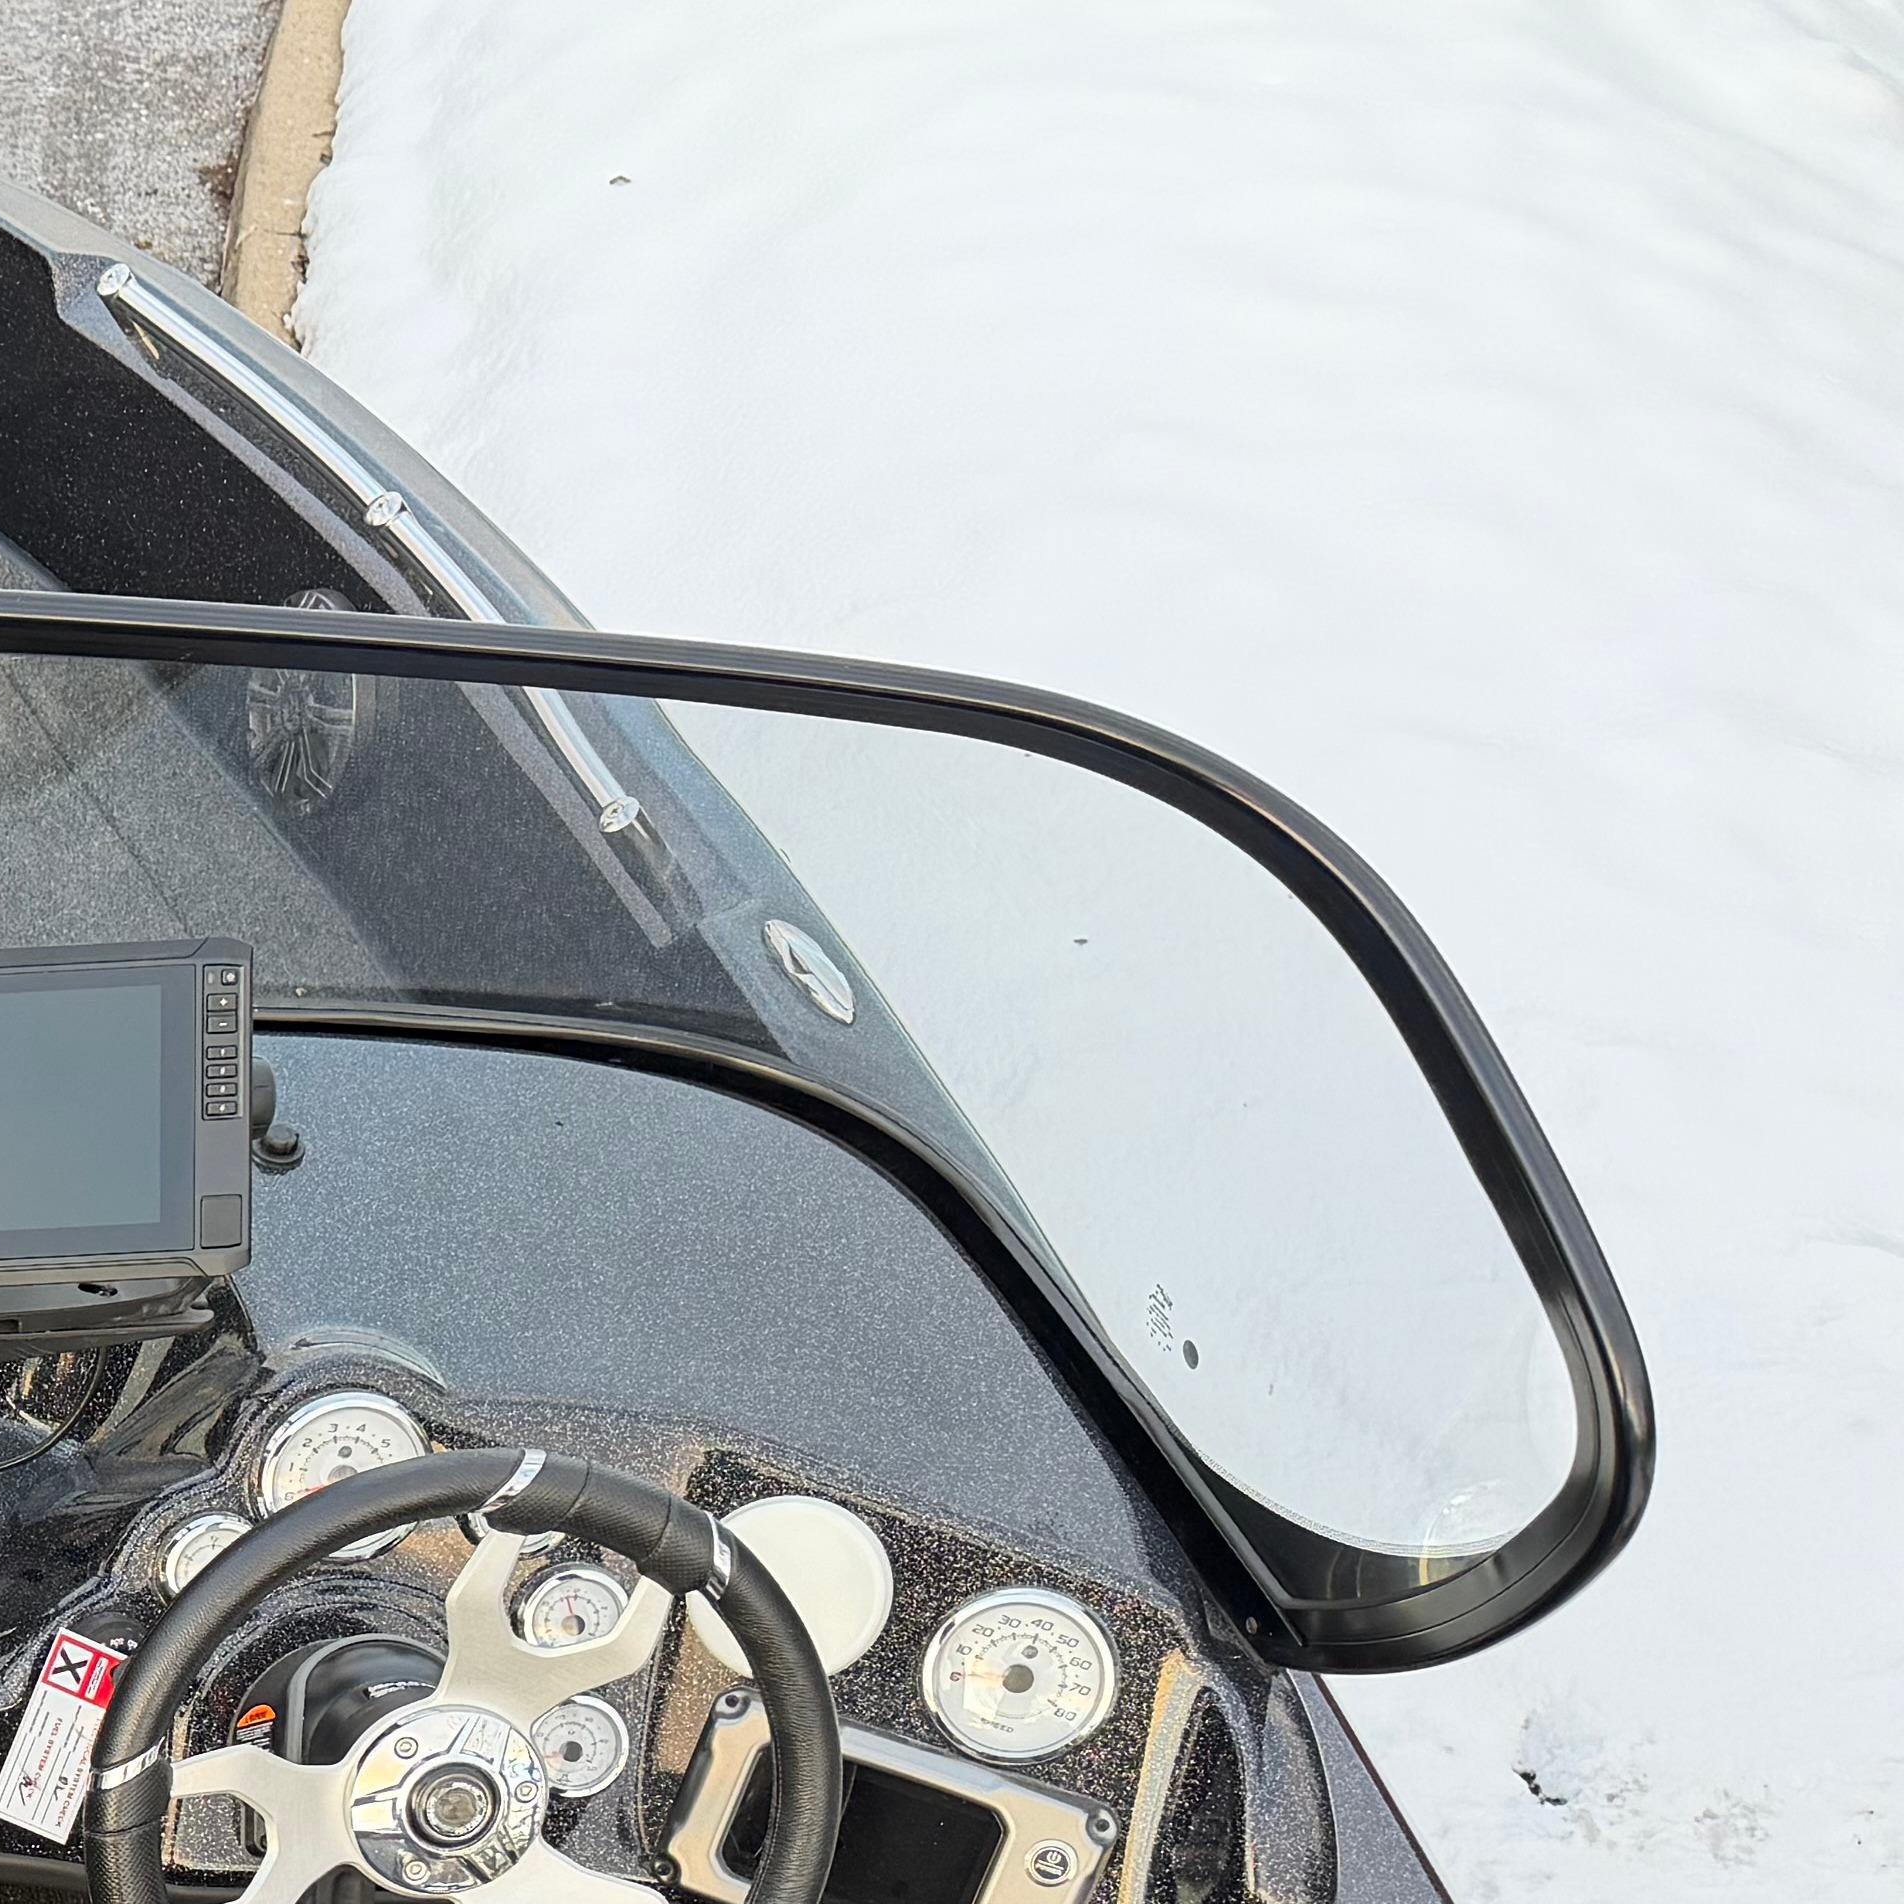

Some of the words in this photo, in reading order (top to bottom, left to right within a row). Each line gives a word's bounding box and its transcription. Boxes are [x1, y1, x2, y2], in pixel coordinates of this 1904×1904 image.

[328, 1423, 338, 1433] 3
[356, 1423, 367, 1433] 4
[302, 1438, 313, 1448] 2
[380, 1438, 391, 1448] 5
[997, 1614, 1022, 1629] 30
[1030, 1618, 1055, 1632] 40
[971, 1623, 995, 1638] 20
[1055, 1634, 1080, 1648] 50
[955, 1643, 973, 1656] 10
[1068, 1656, 1093, 1671] 60
[1067, 1682, 1092, 1696] 70
[1053, 1708, 1078, 1722] 80
